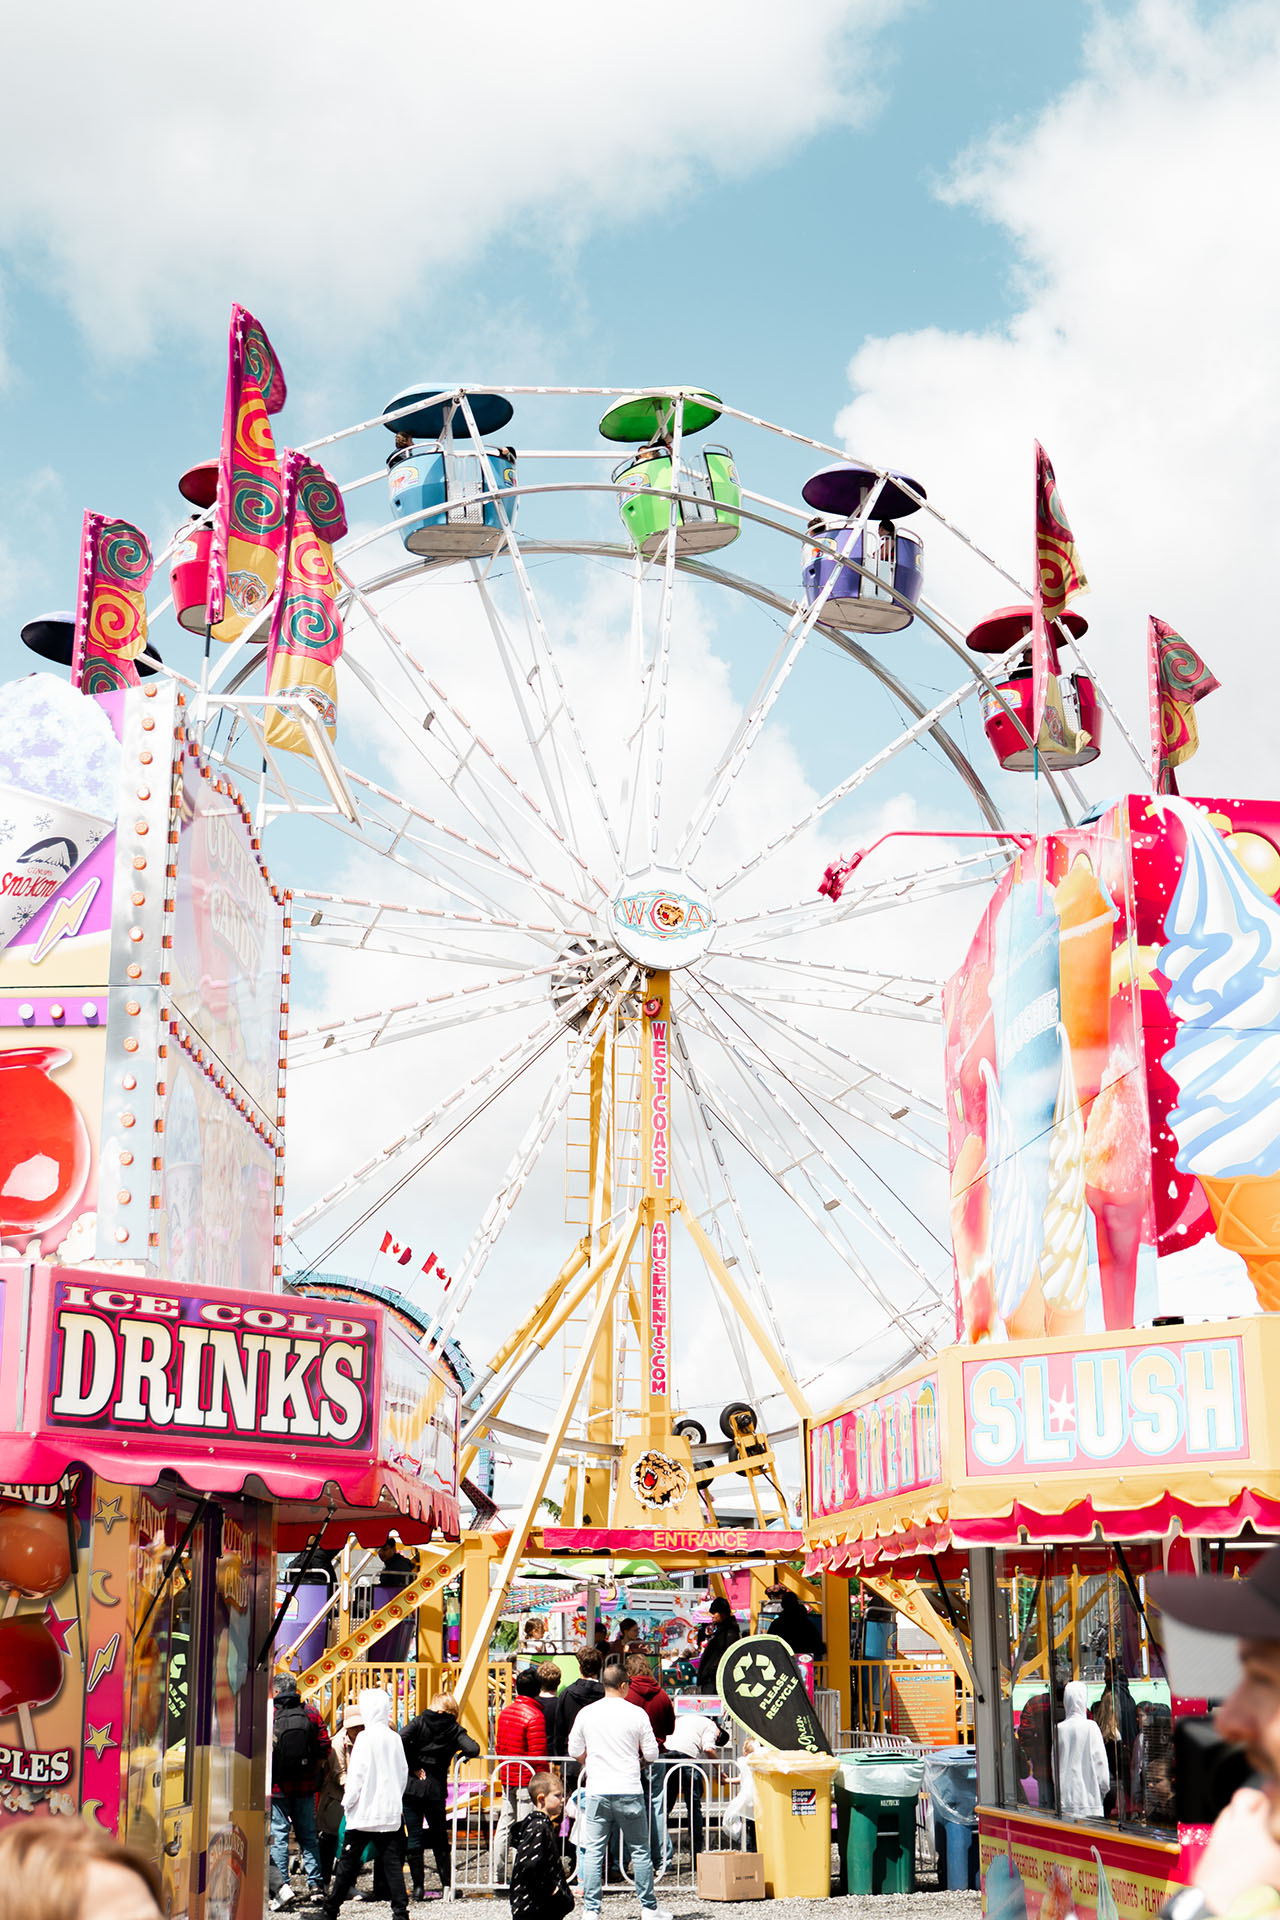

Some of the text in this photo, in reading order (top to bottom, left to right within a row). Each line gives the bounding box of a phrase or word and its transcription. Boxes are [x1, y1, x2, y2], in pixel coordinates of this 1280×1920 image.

[211, 883, 260, 975] CANDY
[622, 897, 708, 933] WCA
[652, 1022, 667, 1394] WESTCOAST AMUSEMENTS.COM
[64, 1285, 368, 1338] ICE COLD
[52, 1311, 366, 1442] DRINKS
[972, 1340, 1243, 1466] SLUSH
[812, 1380, 940, 1513] ICE CREAM
[653, 1531, 749, 1548] ENTRANCE
[759, 1673, 789, 1711] PLEASE
[765, 1676, 799, 1720] RECYCLE
[792, 1789, 812, 1797] Super
